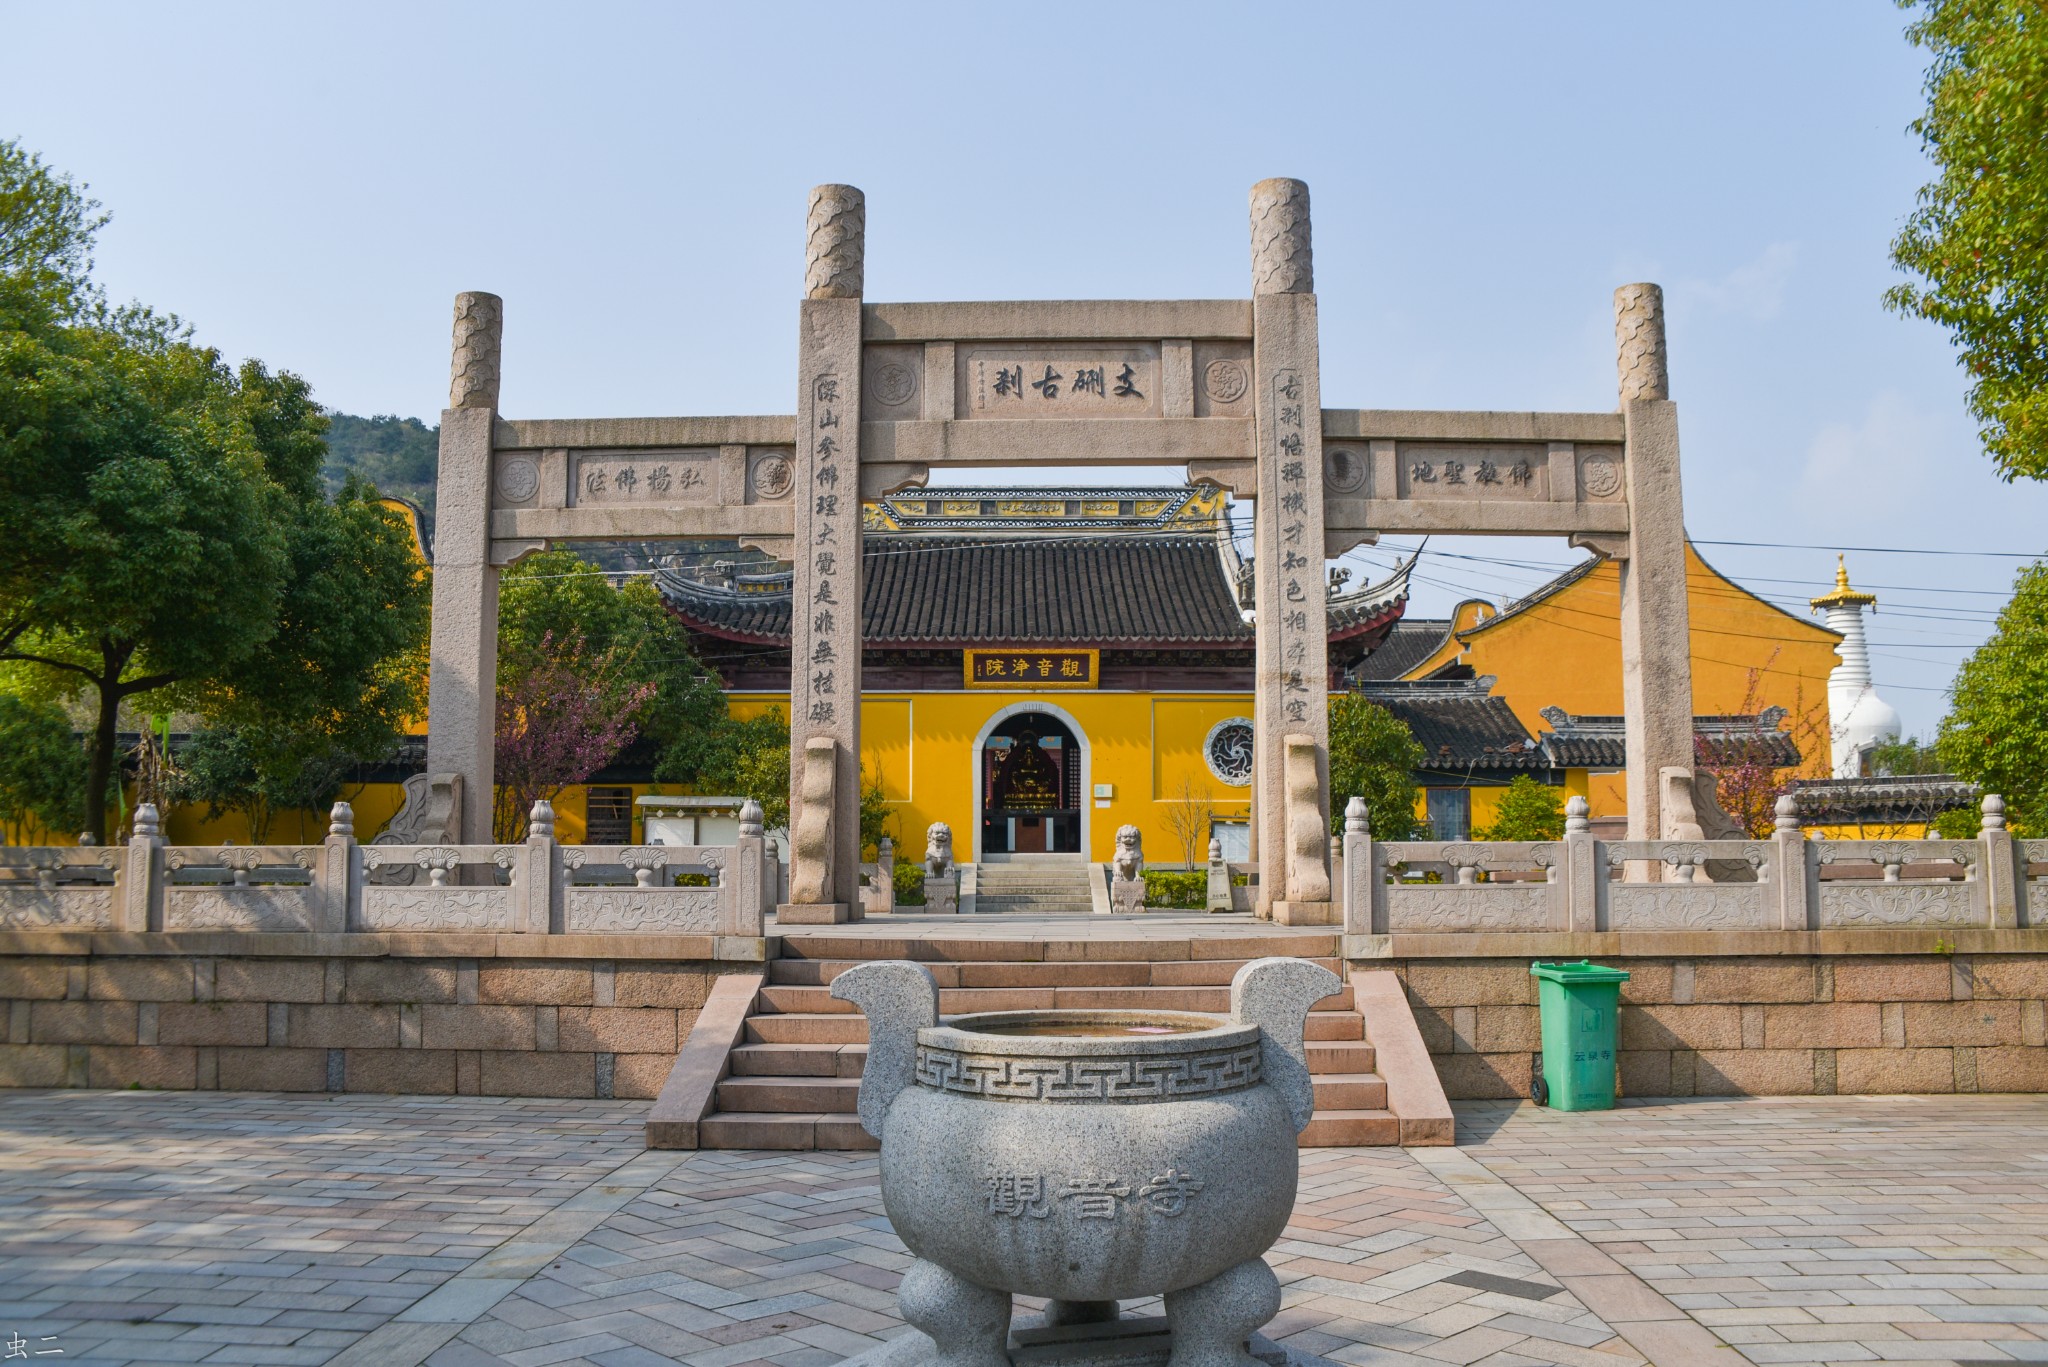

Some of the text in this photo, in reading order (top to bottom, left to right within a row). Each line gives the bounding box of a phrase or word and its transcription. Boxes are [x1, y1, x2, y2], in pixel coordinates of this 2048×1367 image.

[1574, 1050, 1611, 1062] 云泉寺
[983, 1168, 1205, 1220] 觀音寺
